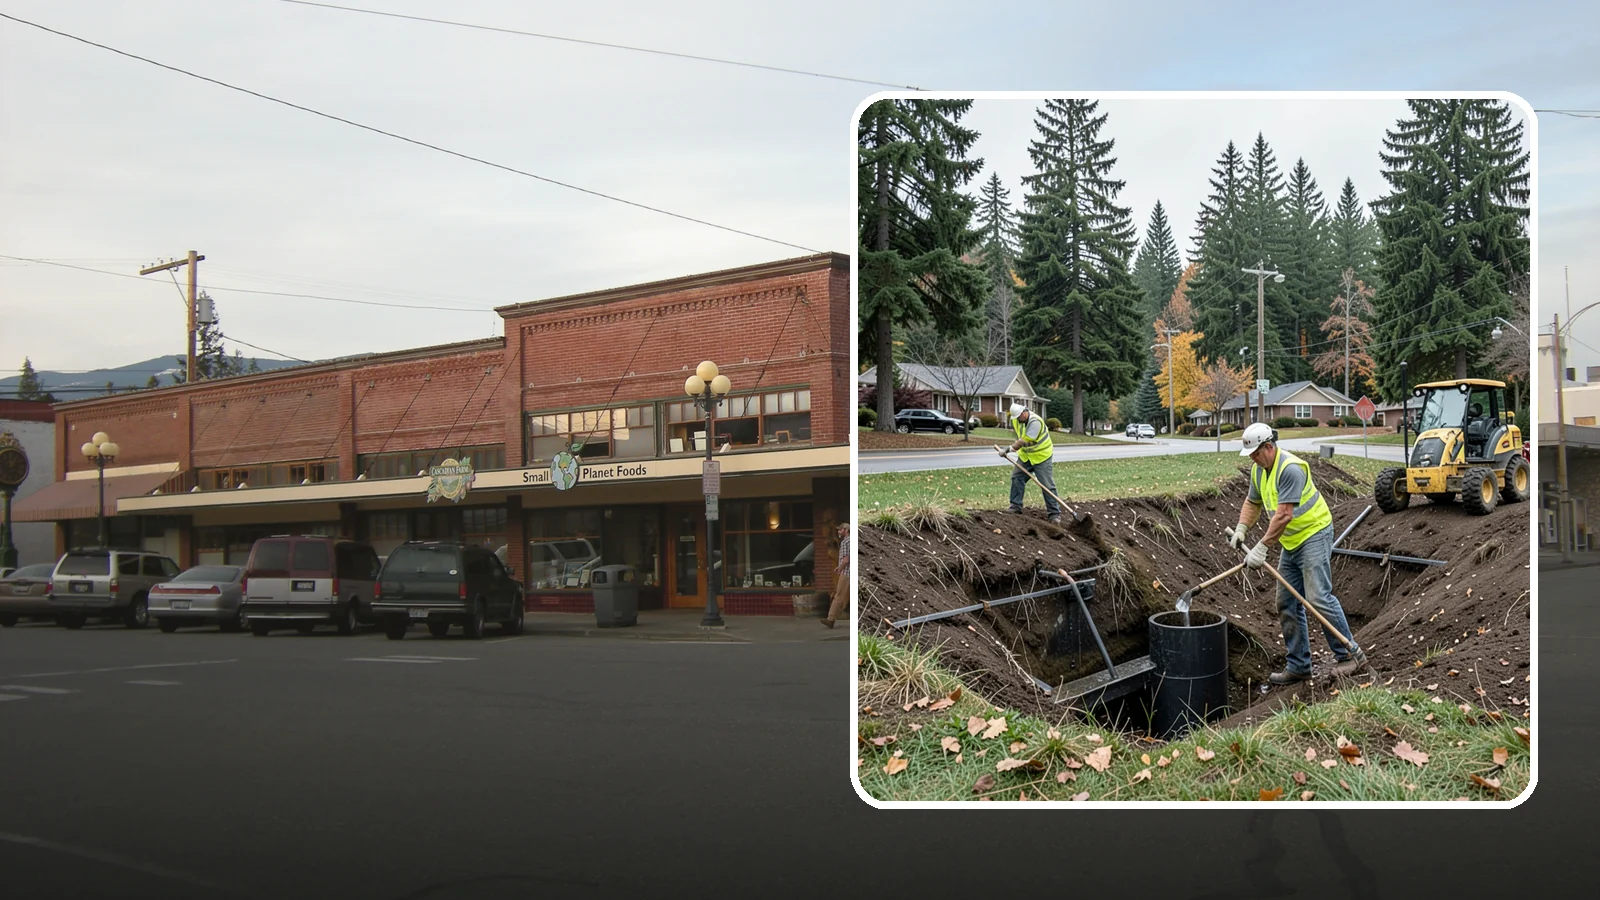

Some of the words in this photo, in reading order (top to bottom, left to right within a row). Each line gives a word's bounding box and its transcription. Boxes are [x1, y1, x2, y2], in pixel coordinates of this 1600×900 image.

[523, 471, 548, 482] Small
[583, 467, 613, 479] Planet
[617, 464, 646, 476] Foods
